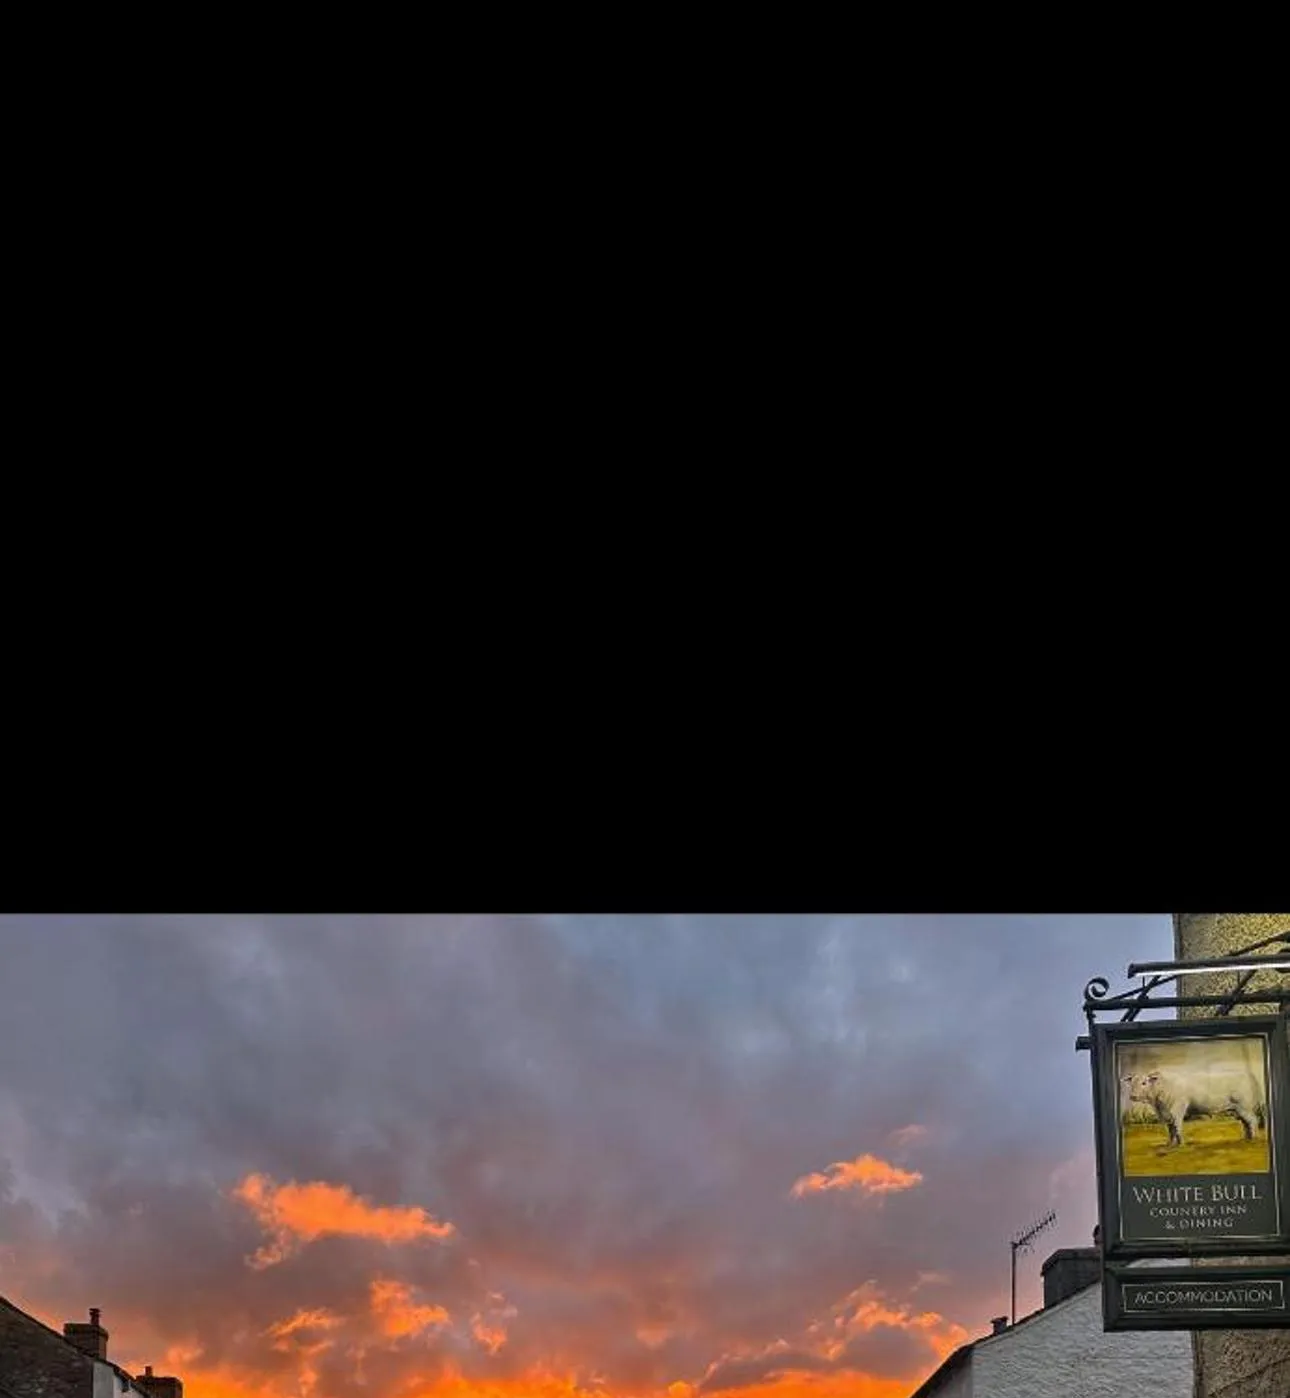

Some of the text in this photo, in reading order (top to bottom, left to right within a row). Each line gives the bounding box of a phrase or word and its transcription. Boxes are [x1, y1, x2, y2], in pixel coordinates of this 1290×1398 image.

[1132, 1184, 1262, 1204] WHITE BULL
[1149, 1204, 1247, 1217] COUNTRY INN
[1164, 1217, 1234, 1229] & DINING
[1134, 1289, 1273, 1304] ACCOMMODATION
